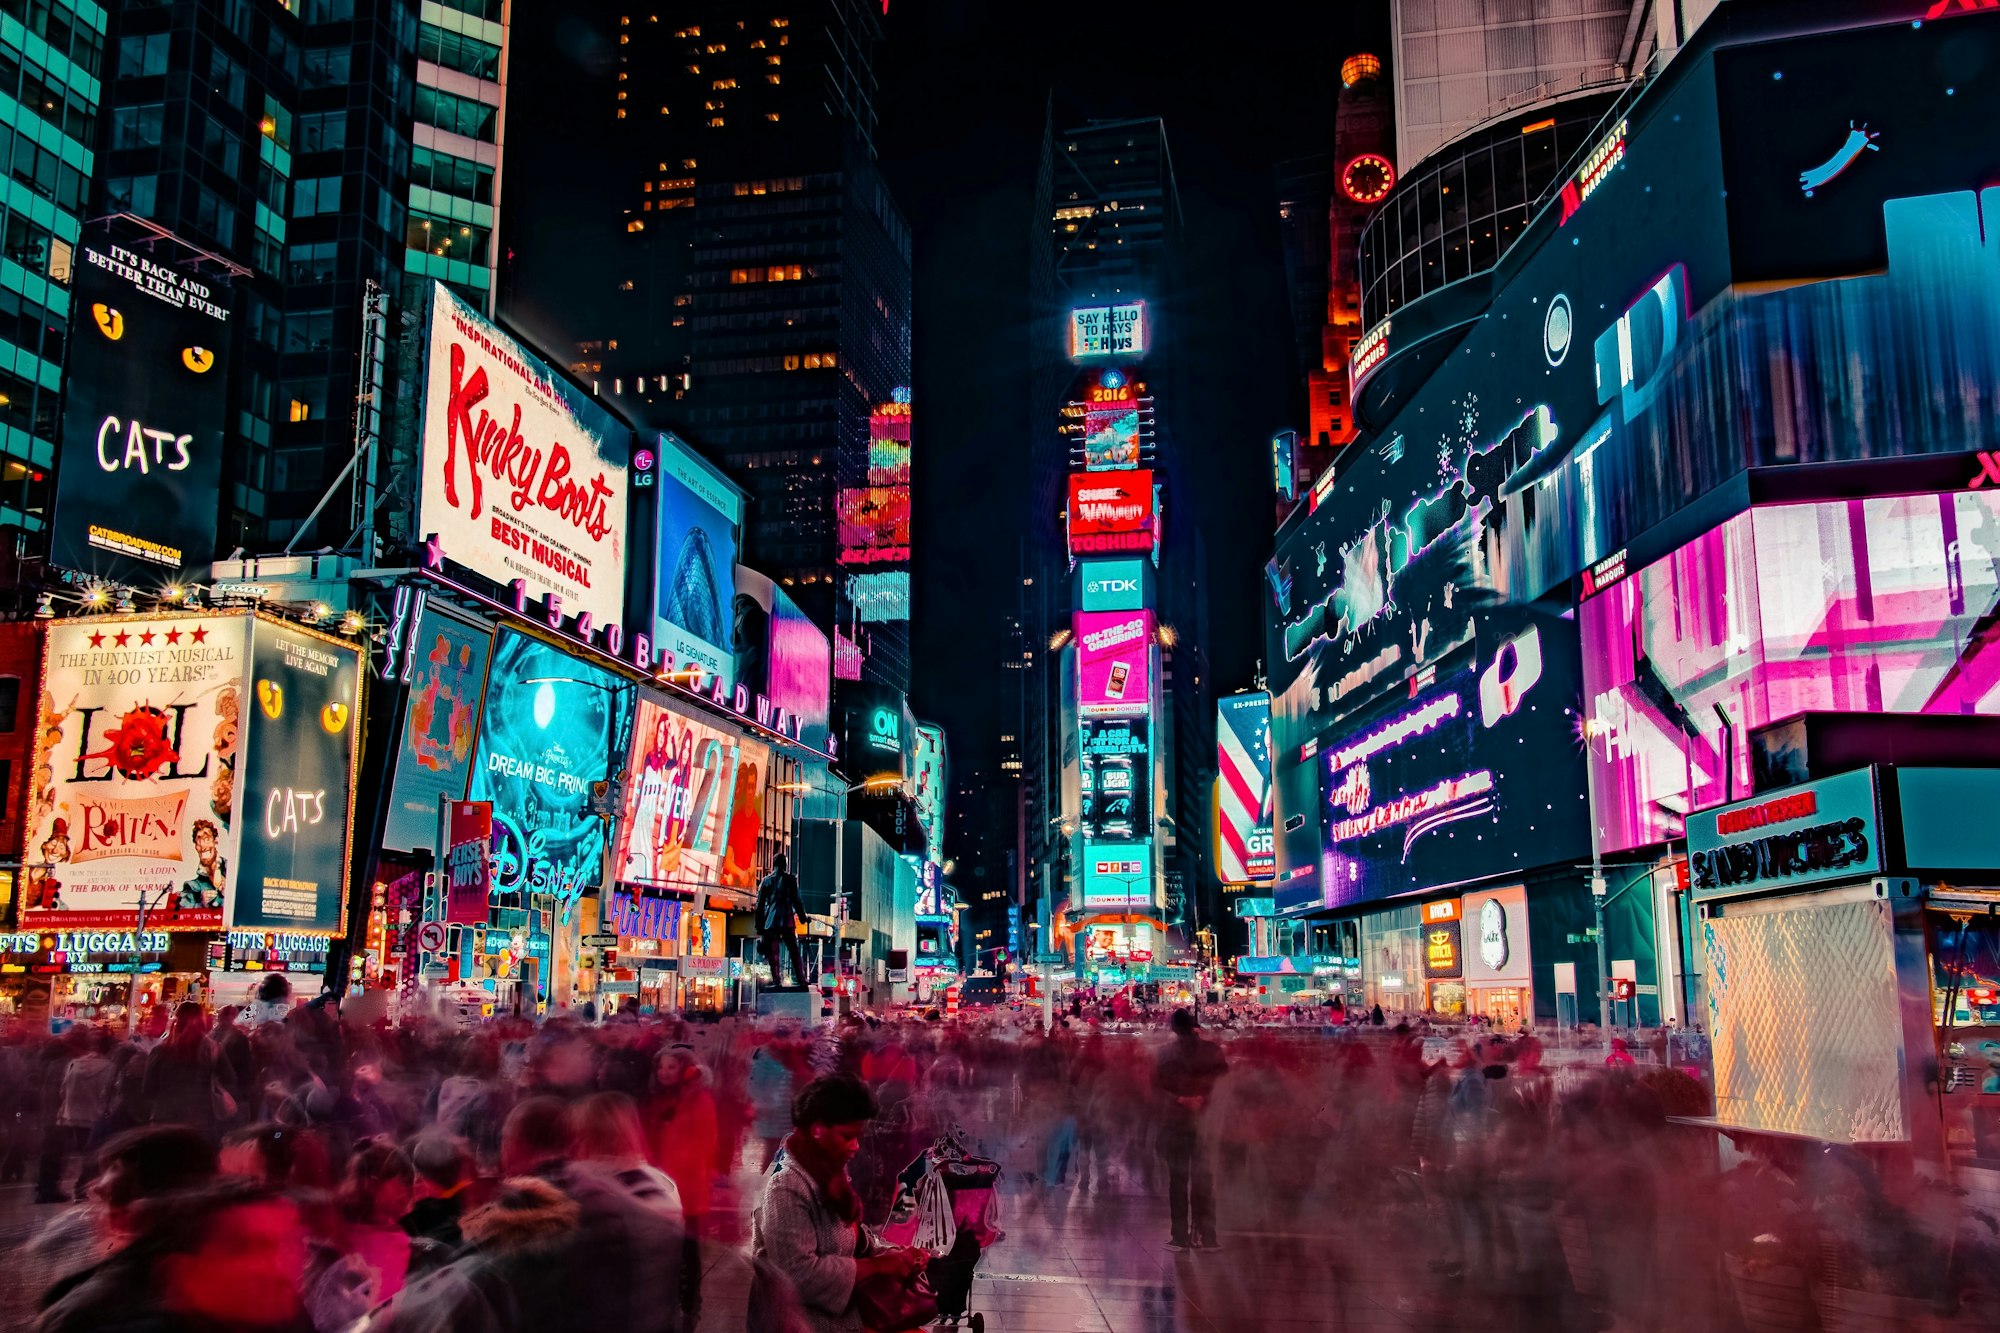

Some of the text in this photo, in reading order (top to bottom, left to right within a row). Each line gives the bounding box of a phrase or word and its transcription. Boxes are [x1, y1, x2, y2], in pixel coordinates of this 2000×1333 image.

[1580, 119, 1628, 183] MARRIOTT
[1581, 146, 1624, 201] MARQUIS
[111, 245, 210, 298] IT'S BACK AND
[146, 276, 186, 303] THAN
[1078, 310, 1138, 325] SAY HELLO
[1084, 323, 1132, 336] TO HAYS
[1354, 321, 1391, 366] MARRIOTT
[1355, 343, 1385, 381] MARQUIS
[534, 377, 551, 398] AND
[1093, 388, 1127, 402] 2016
[1085, 398, 1138, 411] TOSHIBA
[97, 415, 193, 475] CATS
[444, 342, 615, 543] Kinky Boots
[634, 472, 653, 486] LG
[677, 467, 727, 512] THE ART OF ESSENCE
[492, 505, 526, 529] BROADWAY'S
[525, 525, 538, 536] TONY
[540, 532, 549, 542] AND
[89, 525, 182, 559] CATSBROADWAY.COM
[491, 516, 591, 589] BEST MUSICAL
[1071, 531, 1154, 552] TOSHIBA
[1594, 548, 1627, 576] MARRIOTT
[1098, 579, 1138, 592] TDK
[1595, 564, 1624, 588] MARQUIS
[1082, 619, 1144, 645] ON-THE-GO
[1087, 627, 1144, 652] ORDERING
[60, 647, 234, 667] THE FUNNIEST MUSICAL
[275, 639, 339, 668] LET THE MEMORY
[284, 655, 328, 676] LIVE AGAIN
[508, 578, 803, 742] 1540 BROADWAY
[676, 640, 718, 671] LG SIGNATURE
[83, 670, 101, 685] IN
[107, 669, 141, 685] 400
[874, 709, 898, 738] ON
[1098, 729, 1130, 738] A CAN
[1084, 743, 1148, 754] QUEEN CITY.
[1090, 736, 1139, 746] FIT FOR A
[488, 752, 588, 794] DREAM BIG, PRINC
[1103, 779, 1130, 788] LIGHT
[1106, 772, 1128, 780] BUD
[632, 773, 692, 822] FOREVER
[688, 738, 740, 857] 21
[264, 788, 326, 840] CATS
[1717, 791, 1817, 835] DELICATESSEN
[76, 799, 183, 854] ROTTEN!
[450, 840, 482, 867] JERSE
[1247, 859, 1263, 867] NEW
[138, 867, 177, 876] ALADDIN
[453, 862, 483, 887] BOYS
[70, 884, 174, 892] THE BOOK OF MORMO
[193, 913, 212, 921] AVES
[611, 892, 682, 941] FOREVER
[56, 932, 169, 953] LUGGAGE
[228, 932, 331, 953] GIFTS LUGGAGE
[50, 951, 86, 963] I NY
[70, 963, 103, 973] SONY
[279, 951, 291, 961] NY
[287, 962, 310, 971] SONY
[698, 958, 711, 969] POLO
[1280, 978, 1306, 992] 1515
